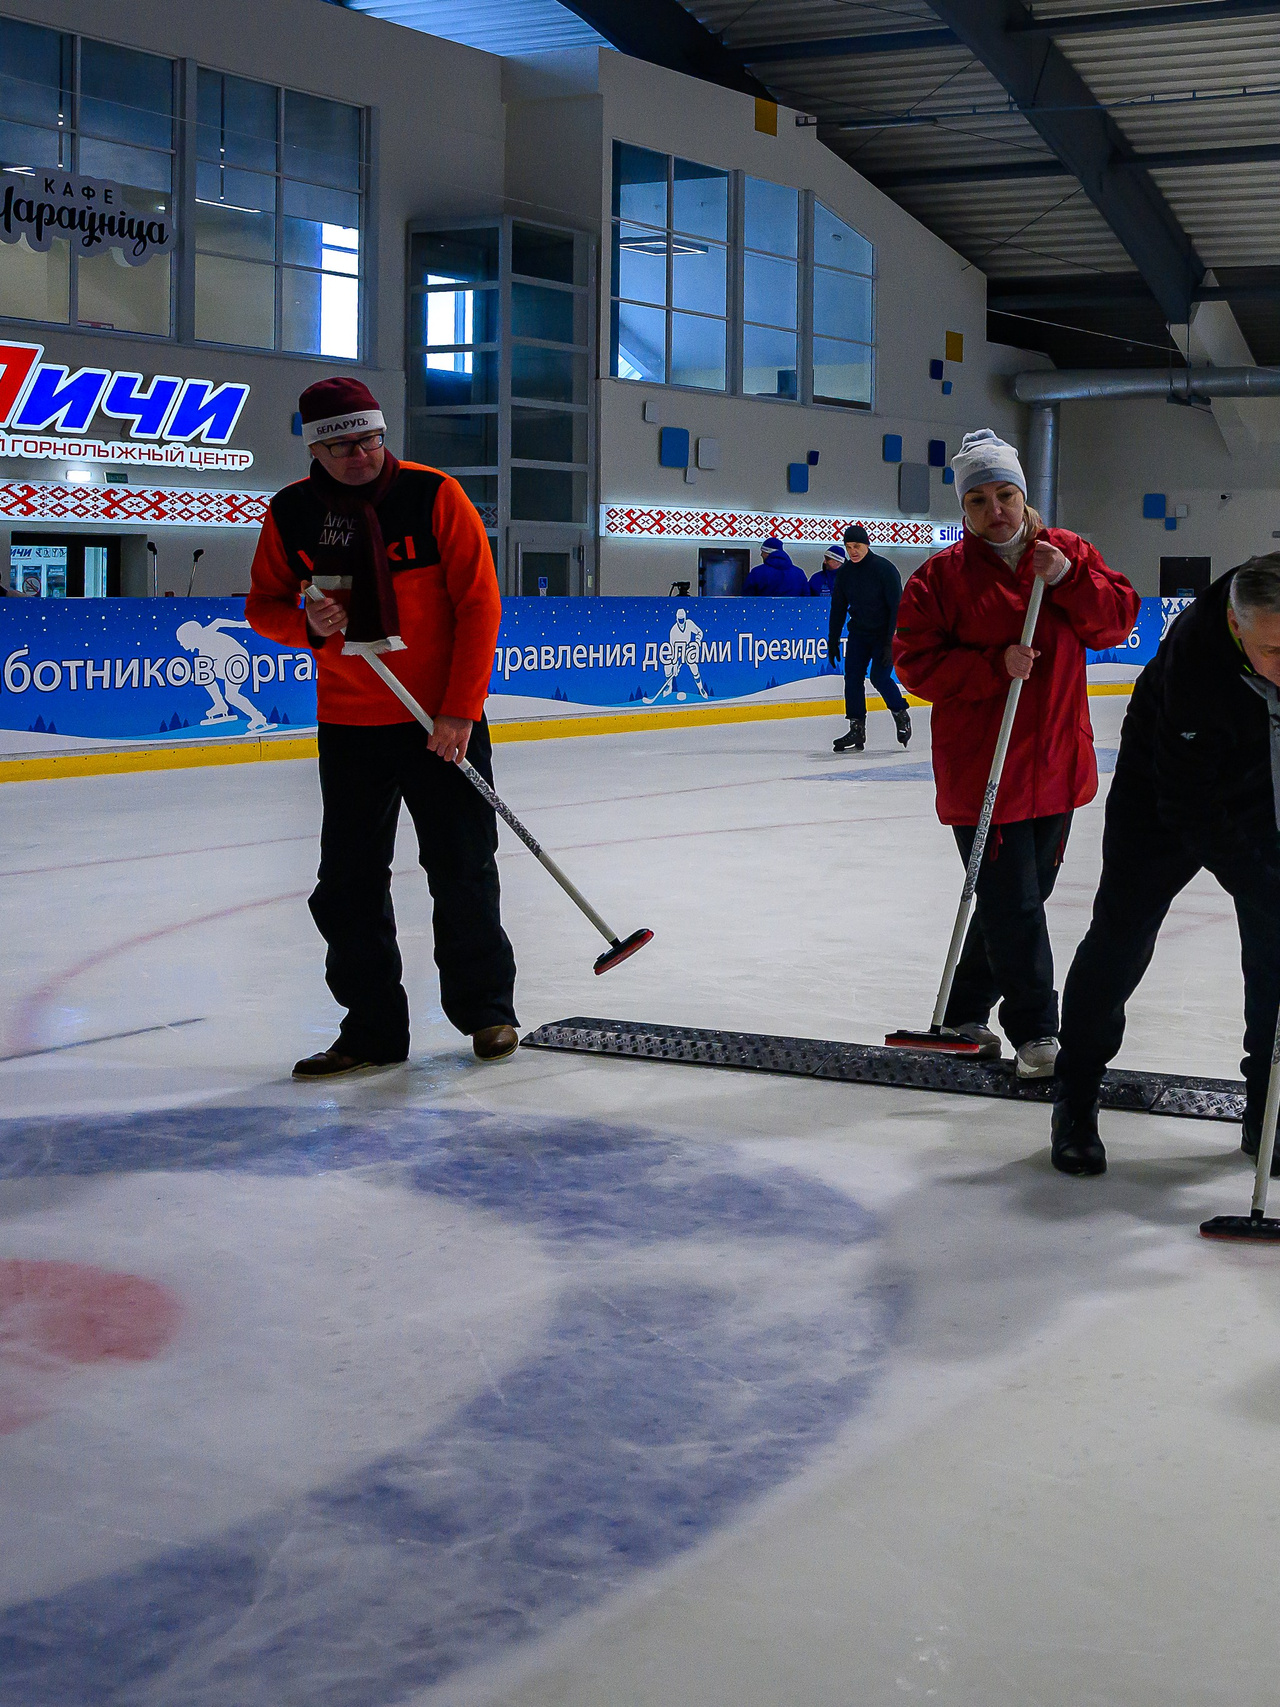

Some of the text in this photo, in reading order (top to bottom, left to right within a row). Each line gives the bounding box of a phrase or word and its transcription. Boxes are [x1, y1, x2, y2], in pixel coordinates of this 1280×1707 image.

[44, 177, 114, 205] КАФЕ
[316, 418, 368, 435] БЕЛАРУСЬ
[11, 439, 184, 463] ГОРНОЛЫЖНЫЙ
[189, 451, 250, 471] ЦЕНТР
[223, 652, 318, 693] орга
[642, 640, 732, 672] делами
[738, 632, 848, 669] Президет
[1115, 626, 1141, 649] 6
